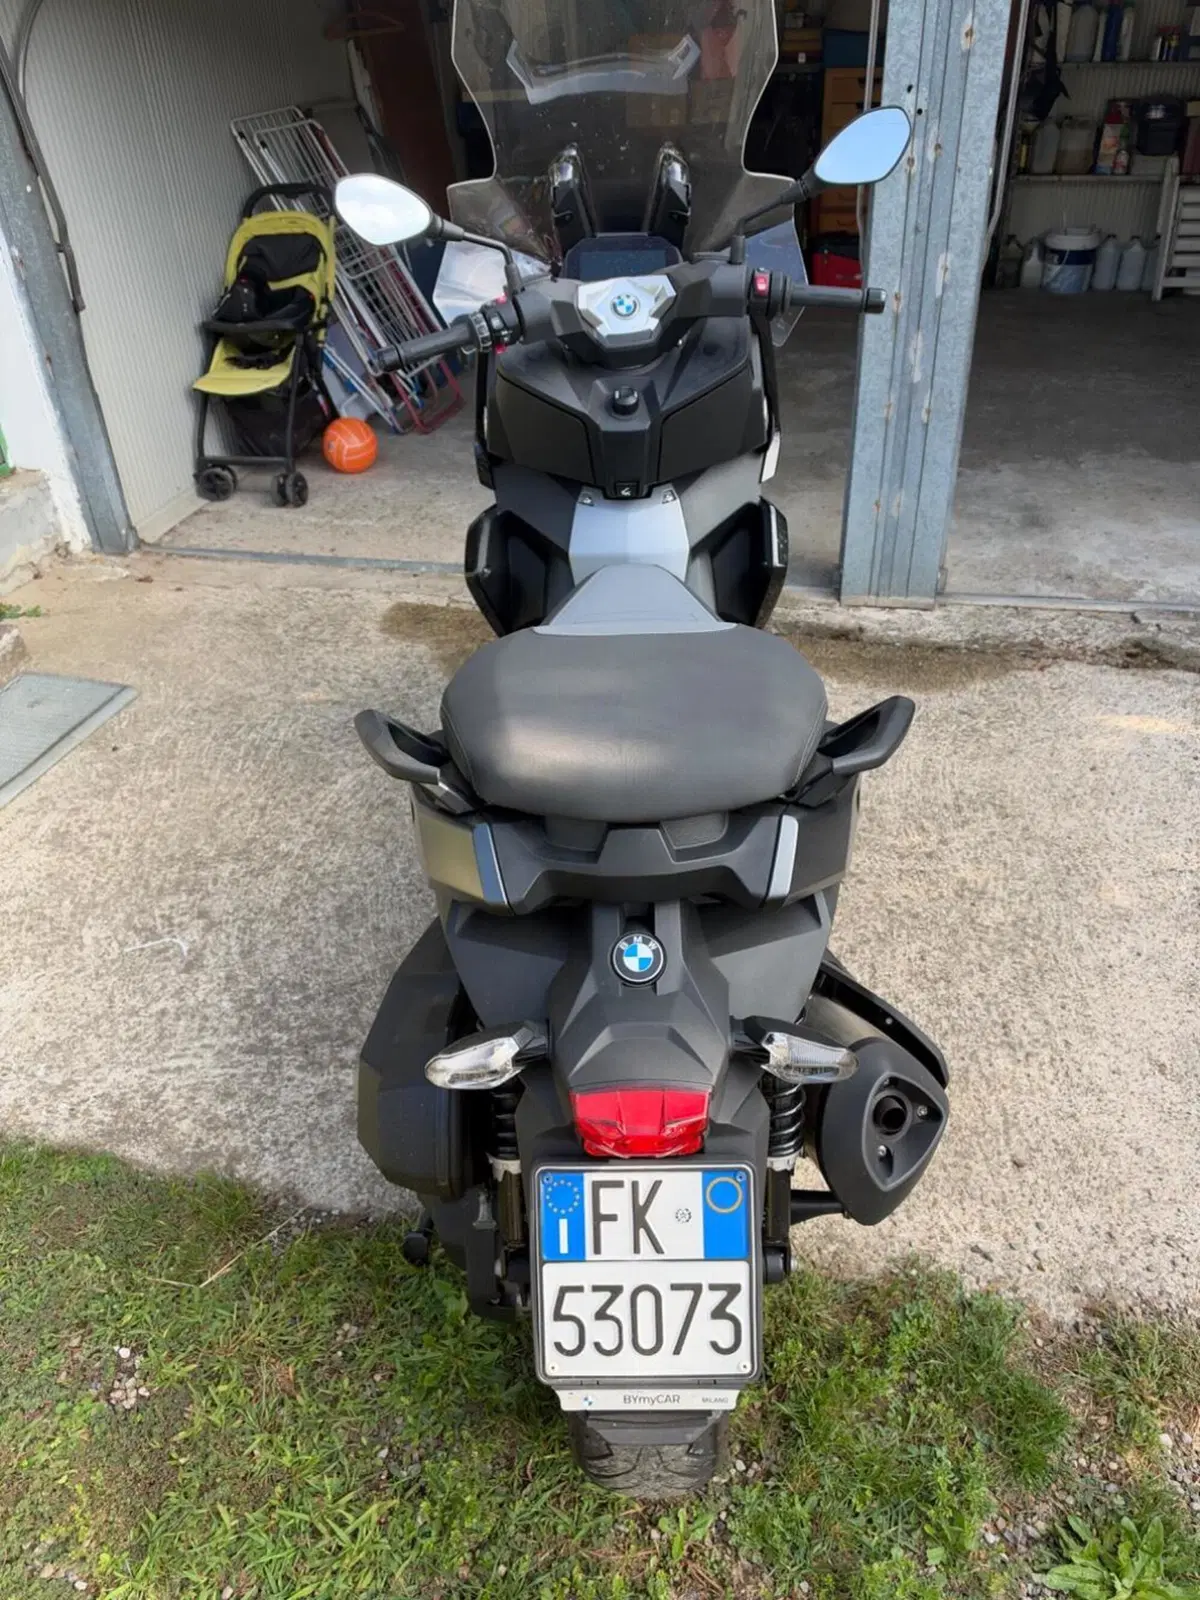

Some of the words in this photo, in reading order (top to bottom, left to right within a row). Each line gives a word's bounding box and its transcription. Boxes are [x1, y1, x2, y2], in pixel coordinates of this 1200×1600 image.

[618, 936, 657, 951] BMW
[591, 1180, 665, 1255] FK
[553, 1282, 742, 1357] 53073
[623, 1394, 681, 1405] BYmyCAR
[702, 1396, 728, 1404] MILANO
